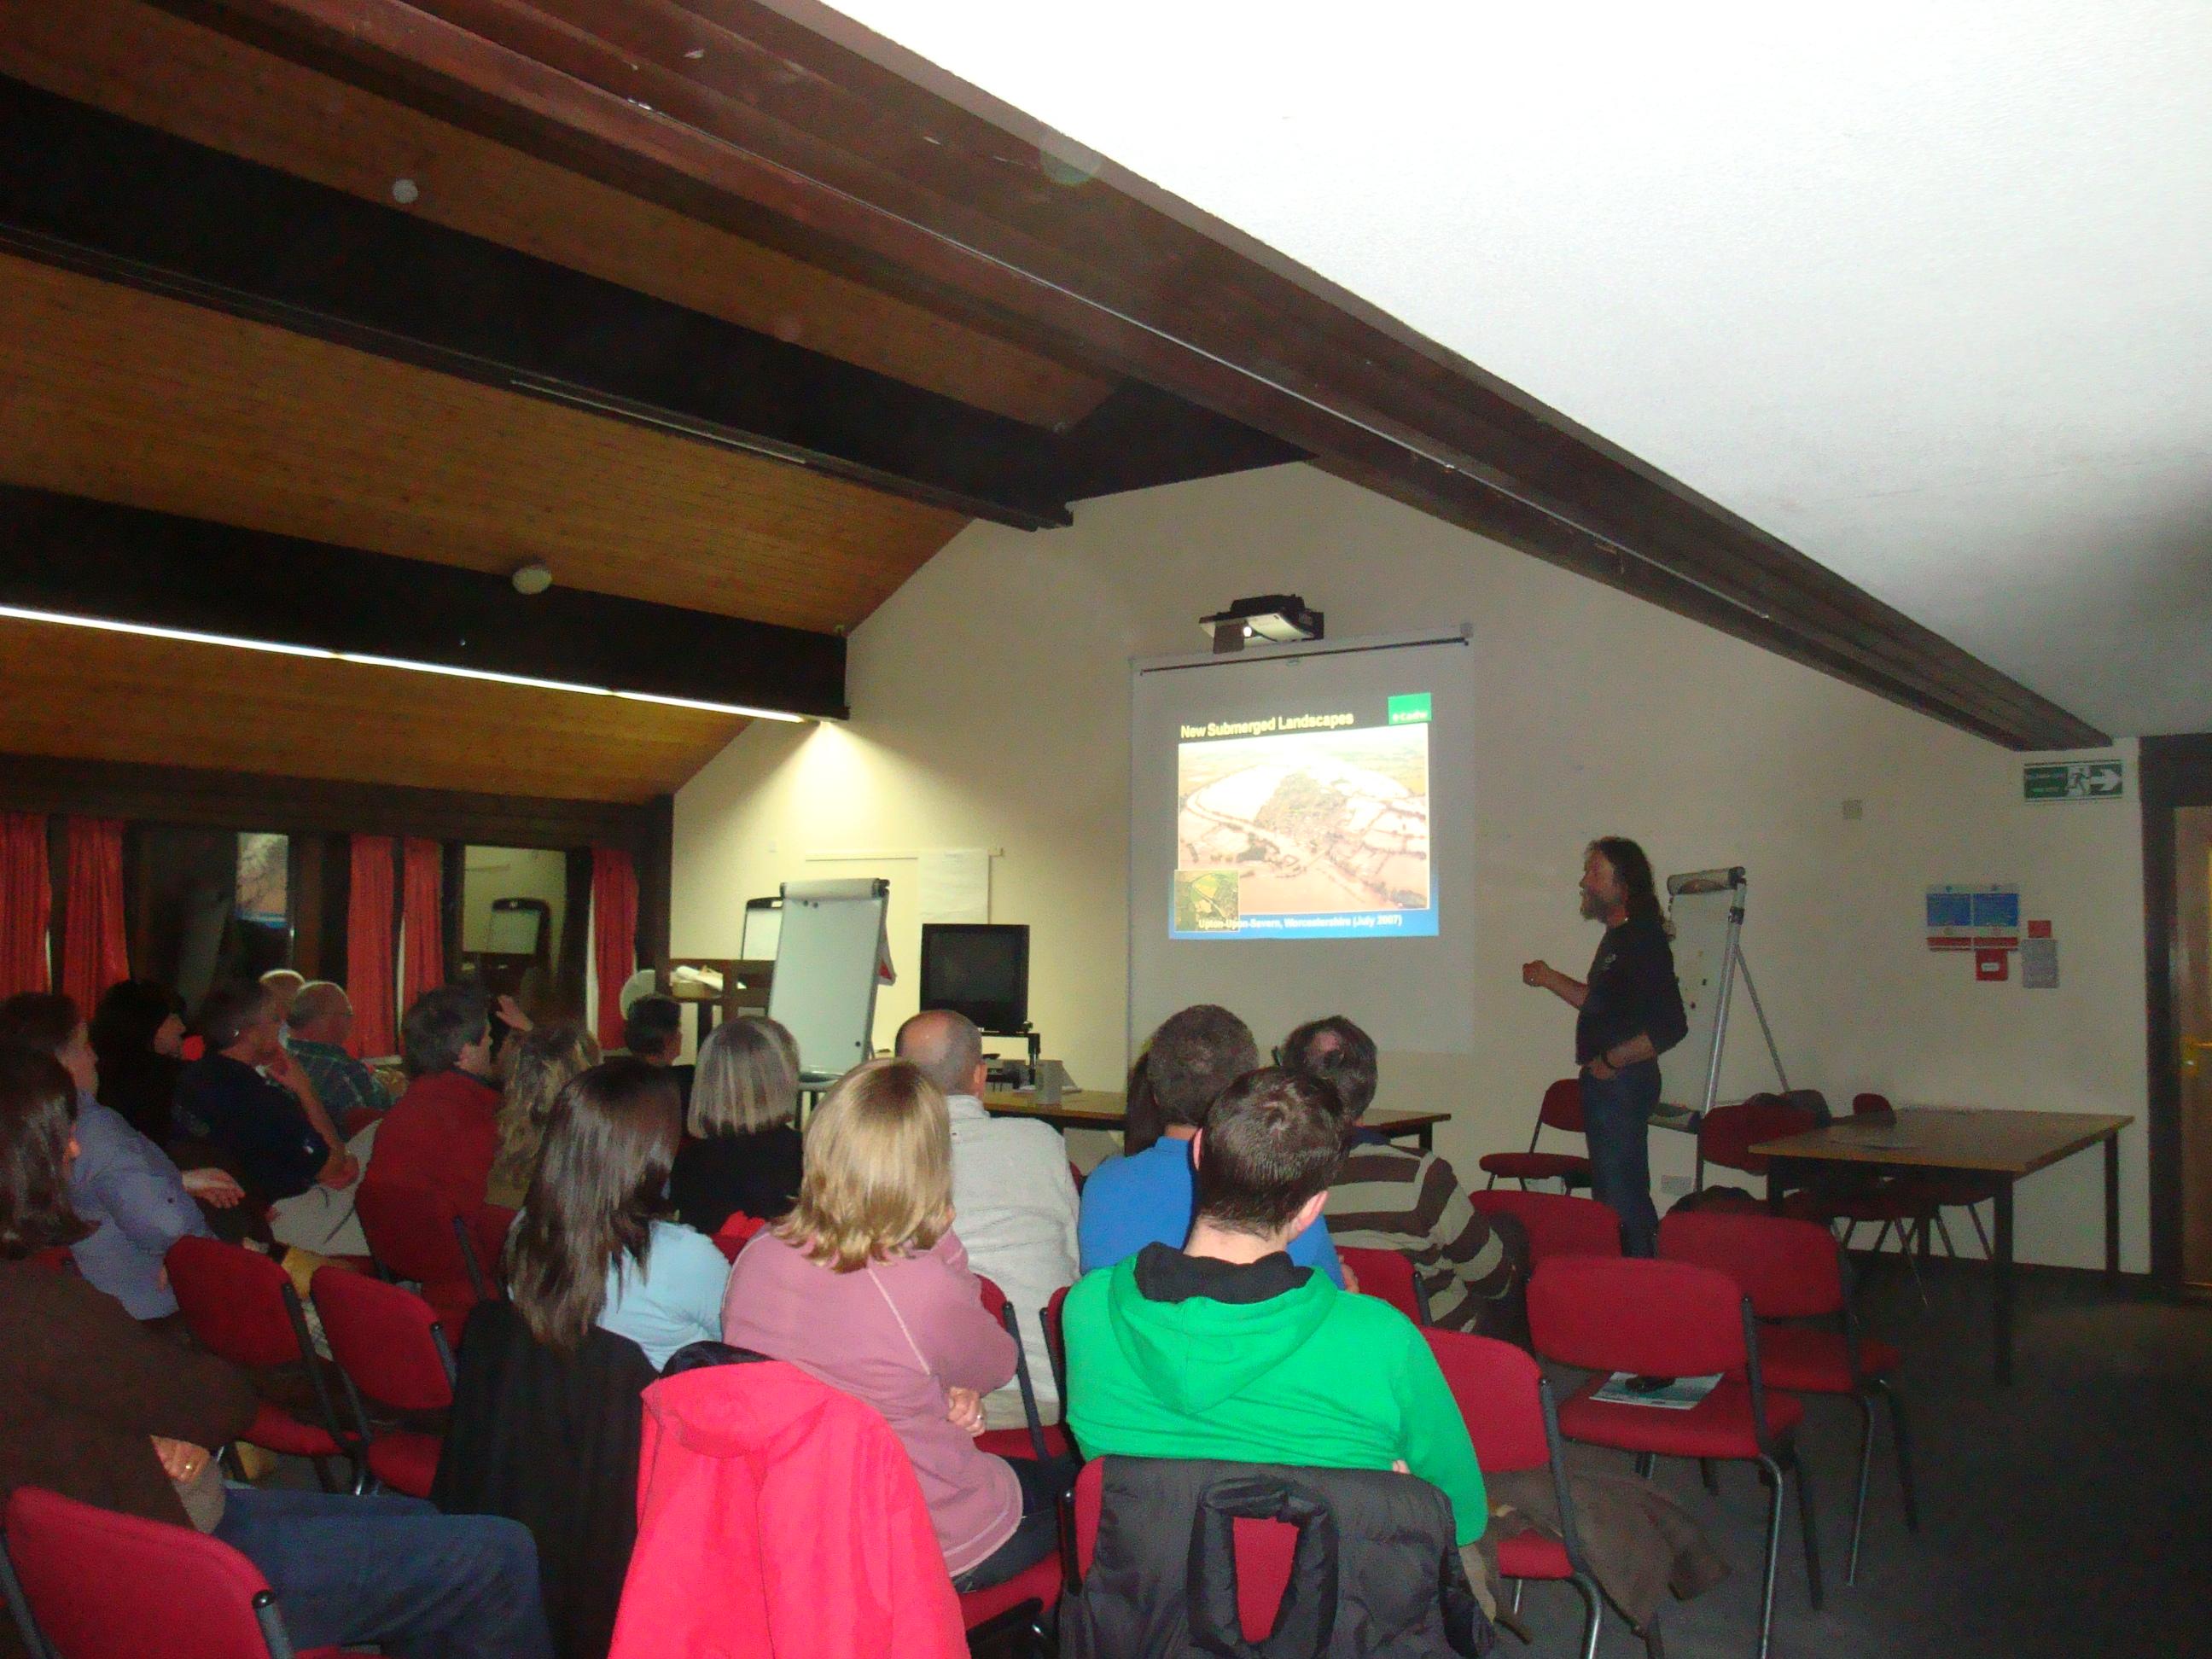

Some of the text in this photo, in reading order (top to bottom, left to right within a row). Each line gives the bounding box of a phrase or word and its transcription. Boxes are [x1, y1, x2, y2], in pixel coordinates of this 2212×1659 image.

[1181, 712, 1354, 738] New Submerged Landscapes
